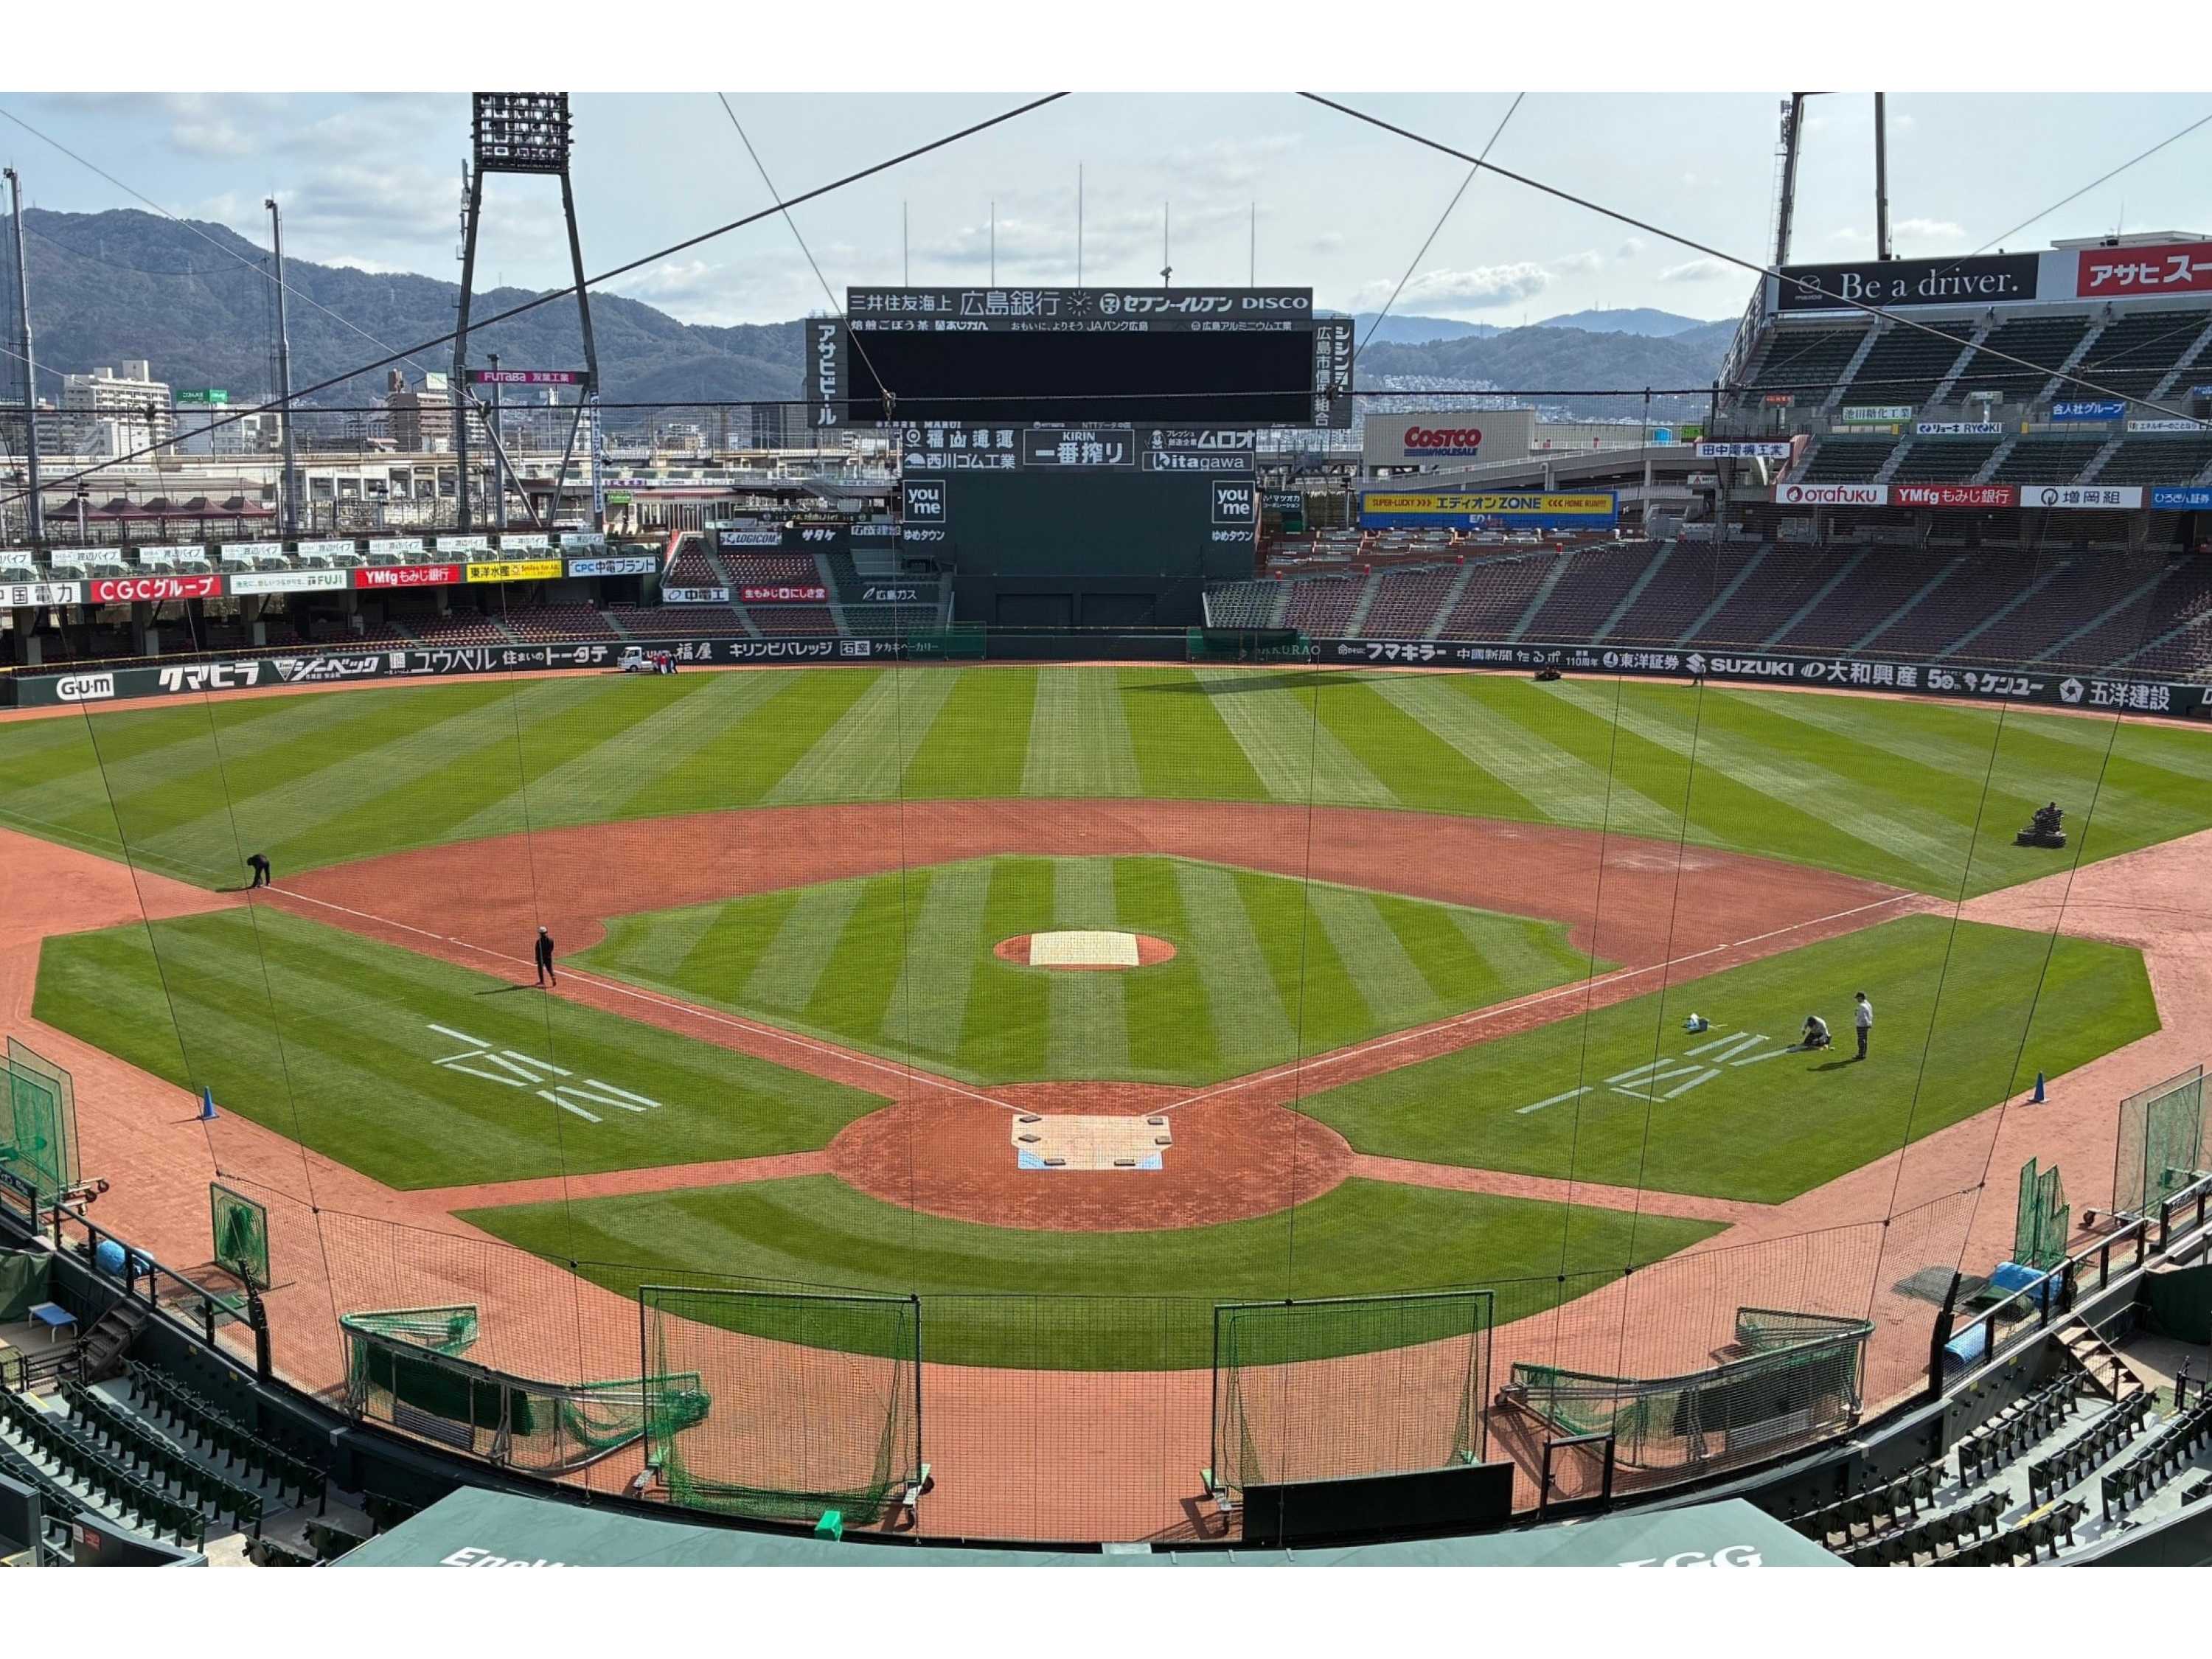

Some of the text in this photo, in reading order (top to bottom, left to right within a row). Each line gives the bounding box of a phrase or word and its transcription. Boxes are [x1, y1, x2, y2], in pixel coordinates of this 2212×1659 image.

[1840, 268, 2019, 299] Be a driver.
[849, 294, 953, 312] 三井住友海上
[960, 290, 1061, 316] 広島銀行
[1242, 297, 1308, 309] DISCO
[1203, 321, 1292, 331] 広島アルミニウム工業
[818, 324, 836, 425] アサヒビール
[926, 429, 1014, 448] 福山通運
[1062, 431, 1095, 441] KIRIN
[1198, 430, 1255, 448] ムロオ
[1405, 426, 1482, 448] COSTCO
[1035, 442, 1122, 464] 一番搾り
[1427, 448, 1477, 456] WHOLESALE
[926, 453, 1015, 470] 西川ゴム工業
[908, 488, 939, 504] you
[1217, 490, 1248, 504] you
[1436, 497, 1542, 509] エディオン ZONE
[1899, 488, 2009, 504] YMfg もみじ銀行
[2062, 490, 2121, 504] 増岡組
[914, 502, 940, 514] me
[1223, 503, 1250, 515] me
[802, 529, 836, 541] サタケ
[904, 529, 945, 541] ゆめタウン
[1212, 530, 1253, 541] ゆめタウン
[575, 559, 654, 574] CPC 中電プラント
[318, 574, 342, 585] FUJI
[366, 568, 449, 585] YMfg もみじ銀行
[100, 577, 214, 601] CGCグループ
[876, 588, 917, 600] 広島ガス
[503, 646, 608, 665] 住まいの トータテ
[677, 642, 712, 660] 福屋
[729, 641, 832, 656] キリンビバレッジ
[1367, 643, 1447, 661] フマキラー
[411, 650, 496, 673] ユウベル
[1620, 653, 1680, 670] 東洋証券
[1711, 658, 1794, 676] SUZUKI
[159, 661, 259, 691] クマヒラ
[1827, 661, 1917, 688] 大和興産
[1980, 673, 2044, 695] ケンユー
[2088, 681, 2170, 711] 五洋建設
